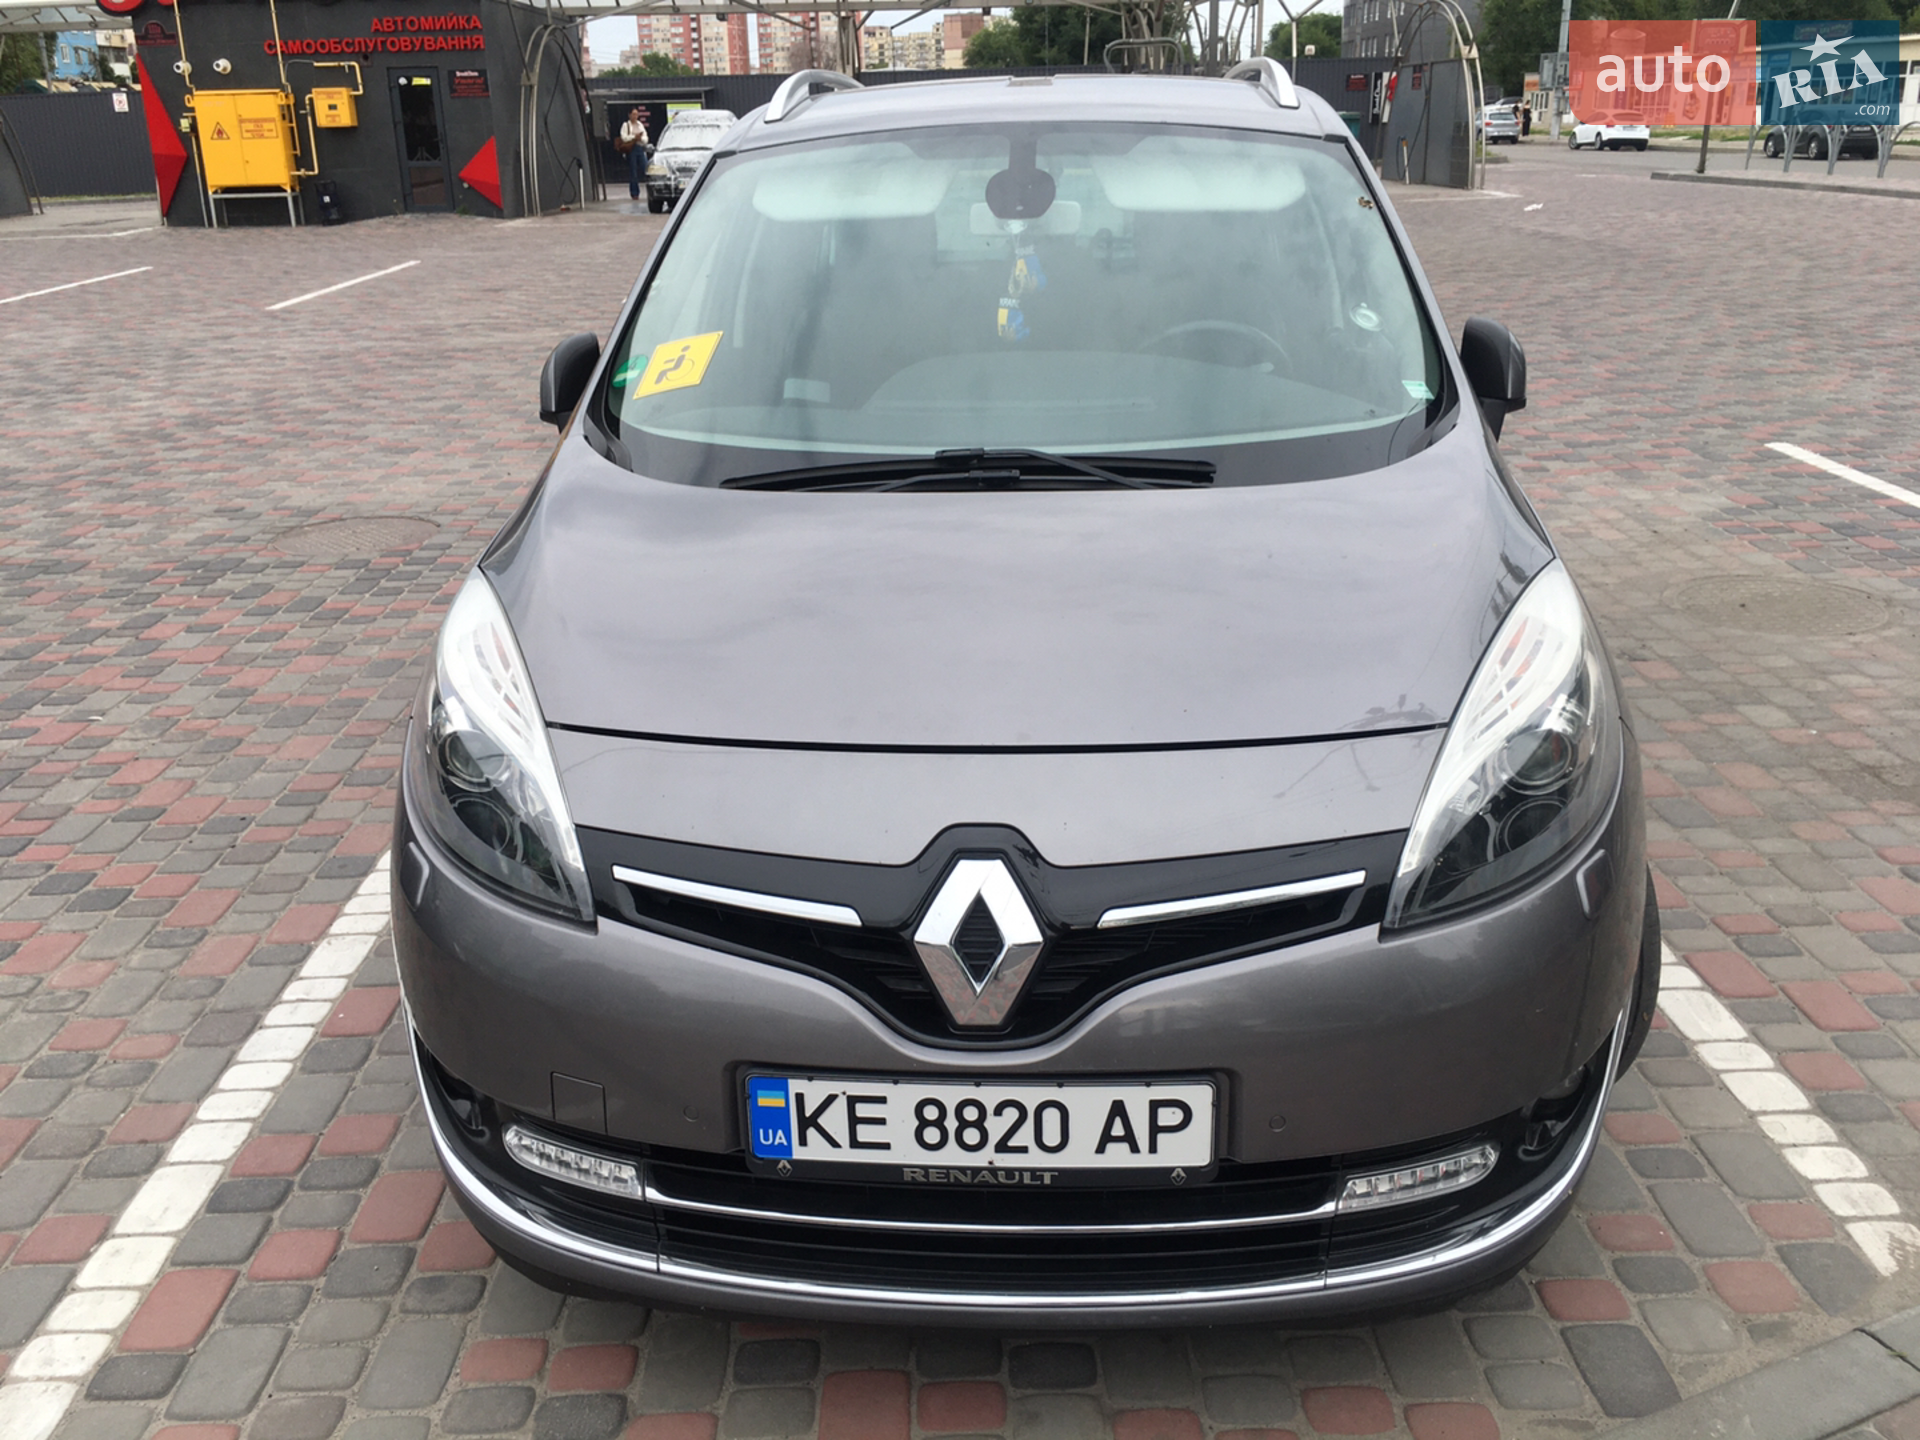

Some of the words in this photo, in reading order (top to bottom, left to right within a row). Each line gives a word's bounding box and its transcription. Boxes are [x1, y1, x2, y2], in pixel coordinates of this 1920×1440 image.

[370, 12, 483, 33] АВТОМИЙКА
[263, 34, 486, 55] САМООБСЛУГОВУВАННЯ
[759, 1128, 788, 1147] UA
[794, 1091, 891, 1150] KE
[913, 1097, 1070, 1155] 8820
[1094, 1098, 1193, 1155] AP
[902, 1166, 1059, 1185] RENAULT
